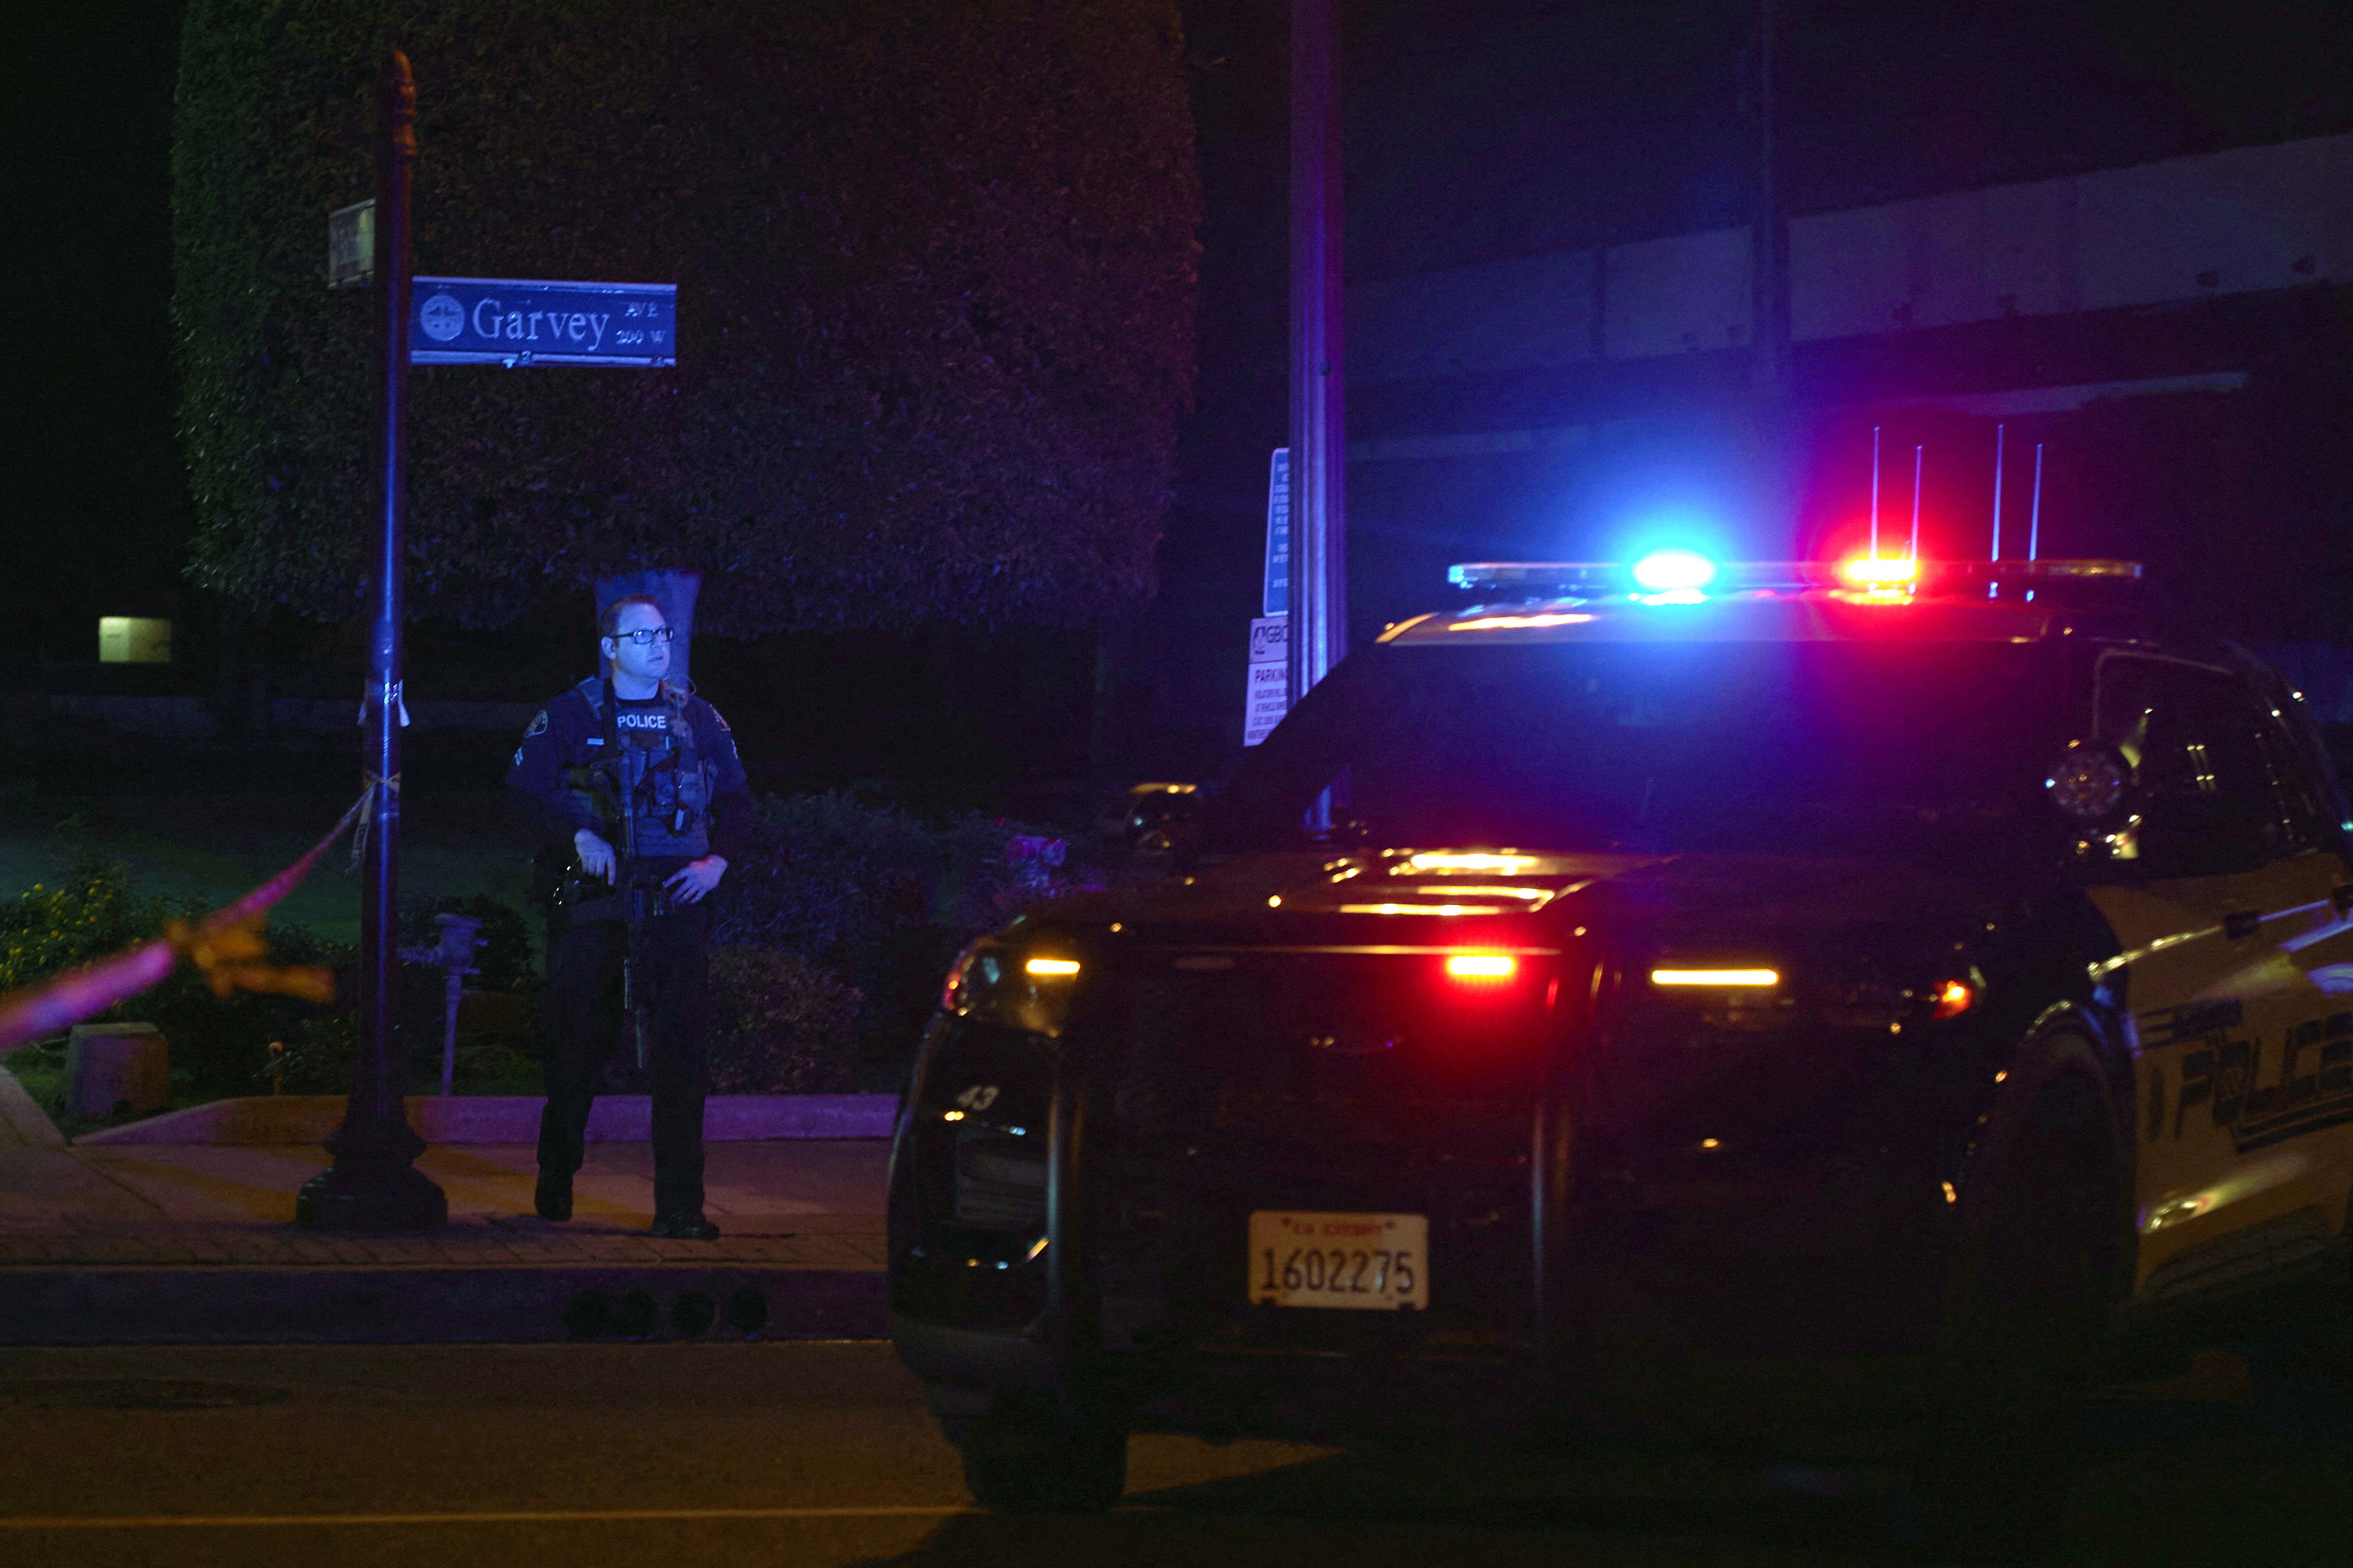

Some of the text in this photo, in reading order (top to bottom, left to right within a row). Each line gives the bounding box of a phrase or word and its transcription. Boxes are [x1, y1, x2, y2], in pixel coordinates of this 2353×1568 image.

[625, 302, 658, 317] AVE
[472, 297, 610, 351] Garvey
[617, 714, 666, 729] POLICE
[958, 1085, 999, 1110] 43
[1262, 1247, 1415, 1294] 1602275
